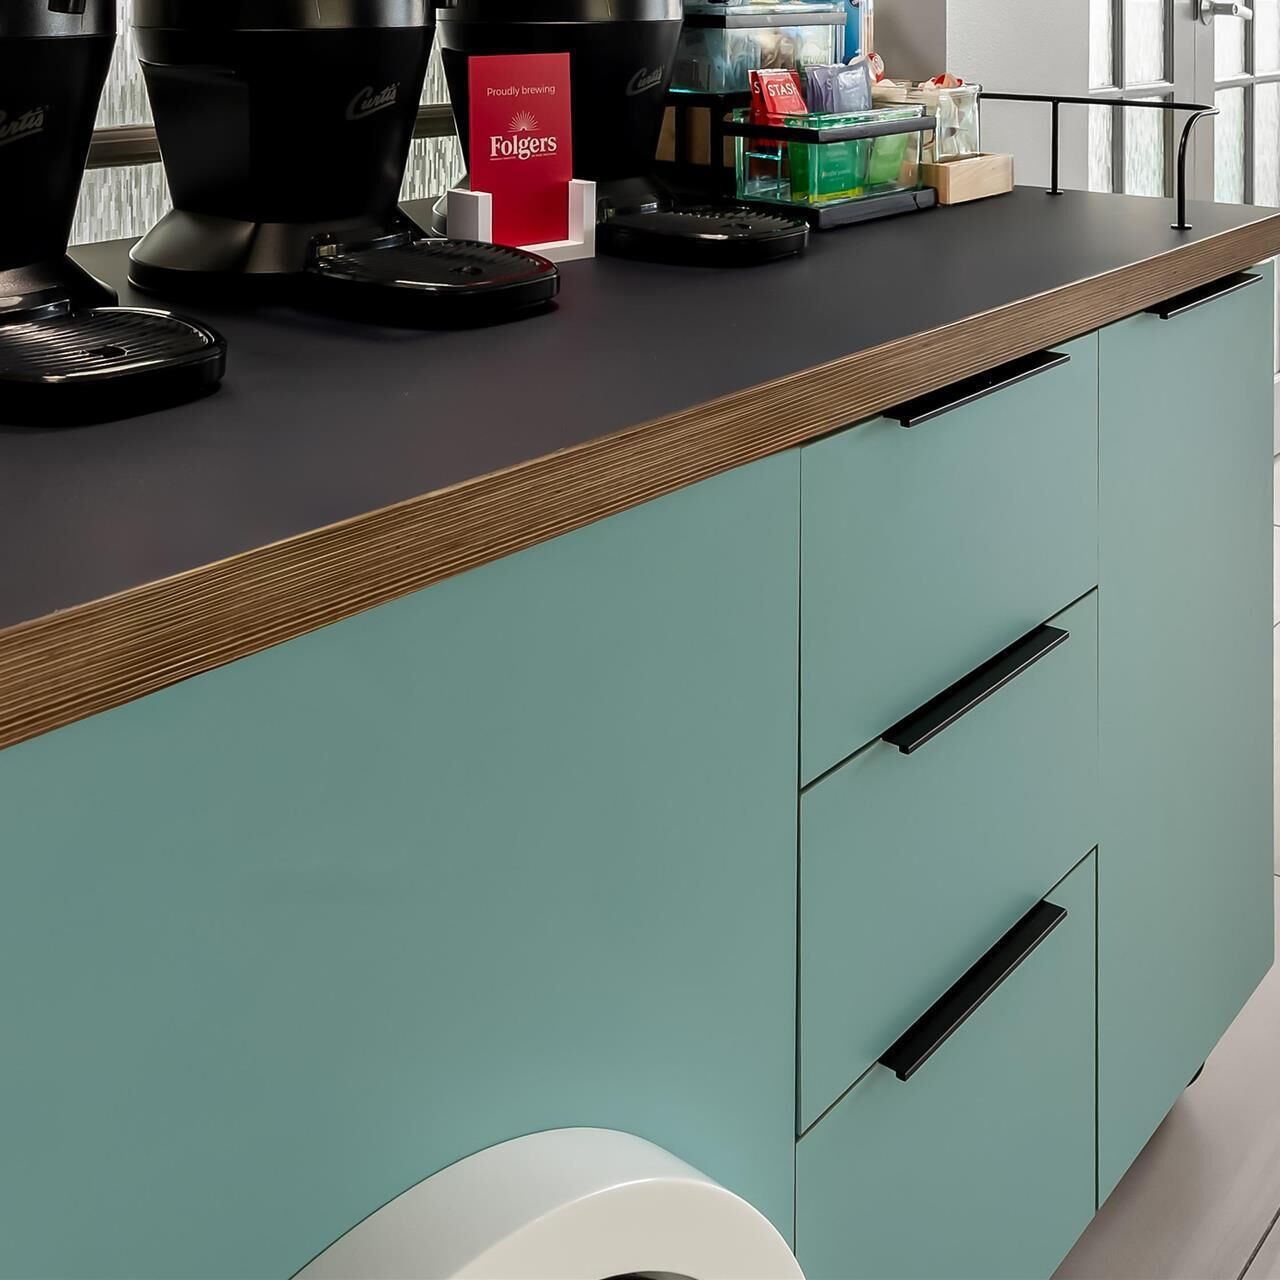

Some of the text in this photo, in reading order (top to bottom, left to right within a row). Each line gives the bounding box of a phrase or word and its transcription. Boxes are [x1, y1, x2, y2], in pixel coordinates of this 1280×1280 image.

[486, 84, 557, 97] Proudly brewing
[489, 135, 558, 160] Folgers
